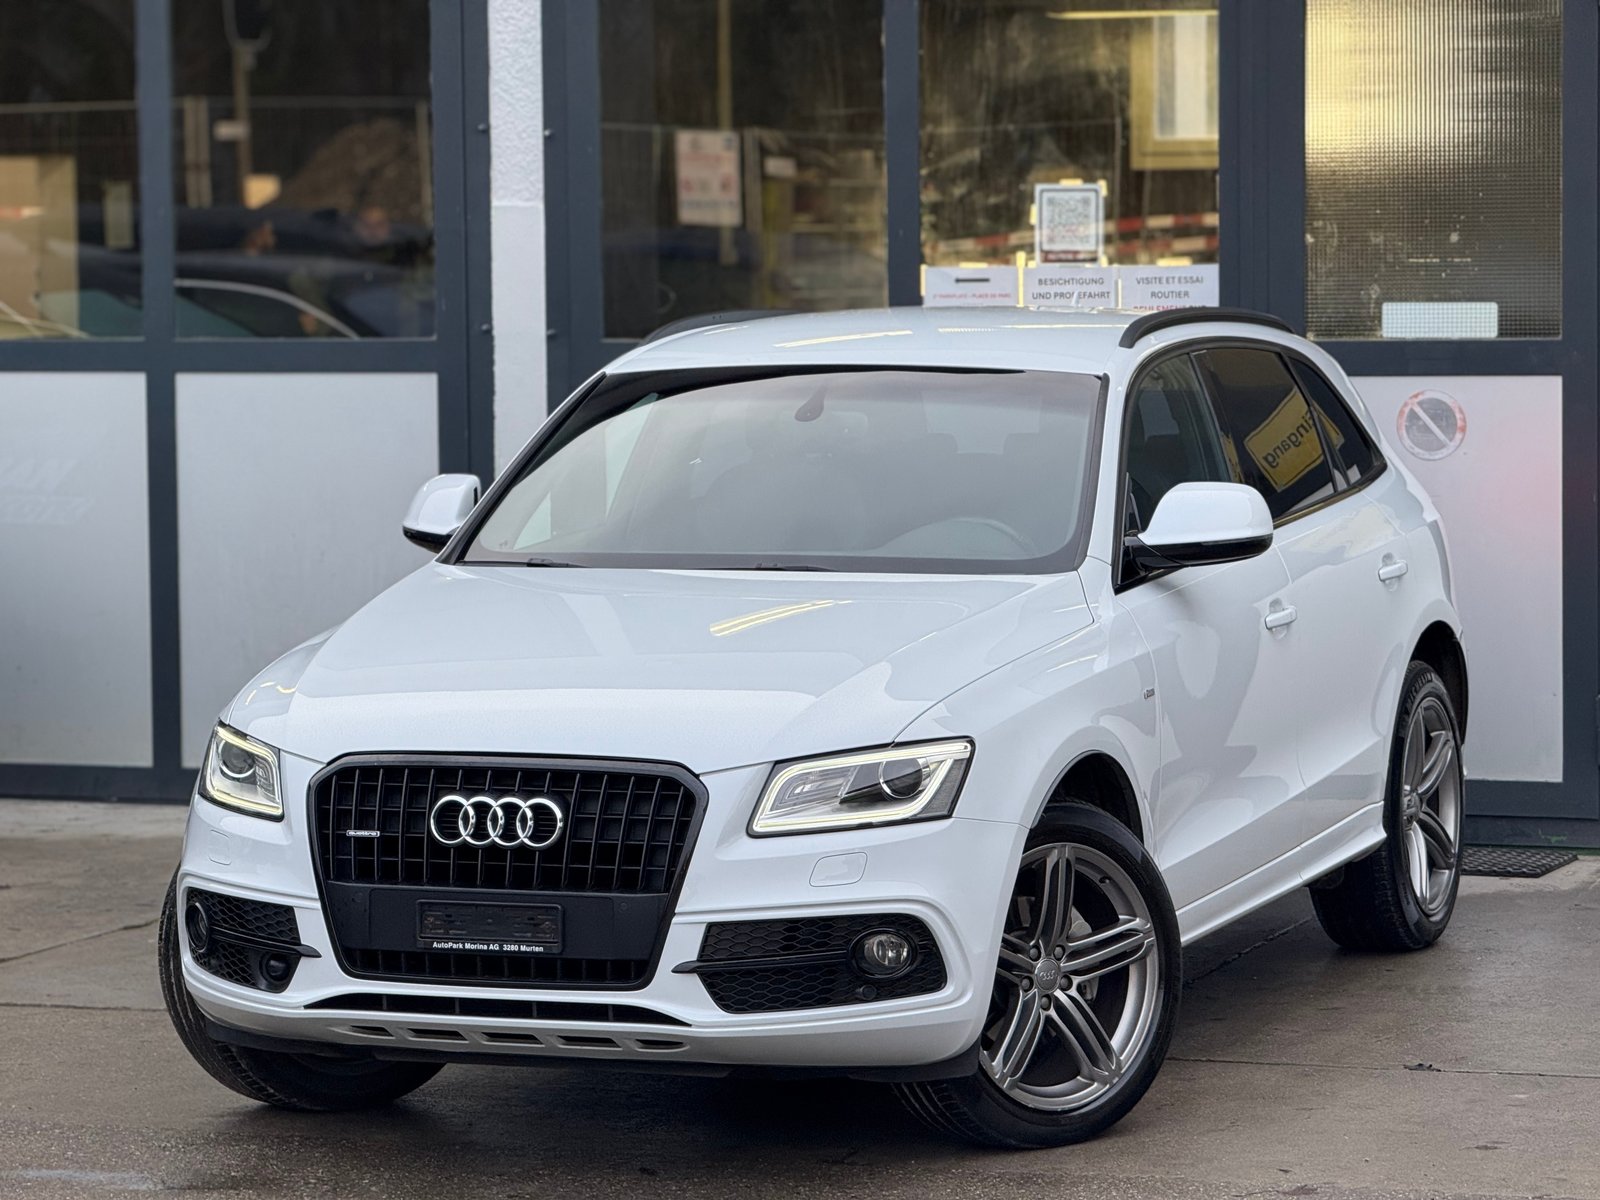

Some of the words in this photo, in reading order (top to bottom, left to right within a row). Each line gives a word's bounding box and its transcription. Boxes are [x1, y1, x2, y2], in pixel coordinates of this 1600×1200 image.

[1037, 277, 1105, 286] BESICHTIGUNG
[1136, 277, 1164, 285] VISITE
[1165, 276, 1176, 284] ET
[1178, 276, 1204, 284] ESSAI
[1032, 291, 1052, 300] UND
[1150, 290, 1190, 299] ROUTIER
[432, 941, 463, 949] AutoPark
[464, 942, 488, 950] Morina
[488, 943, 500, 951] AG
[520, 944, 544, 952] Murten
